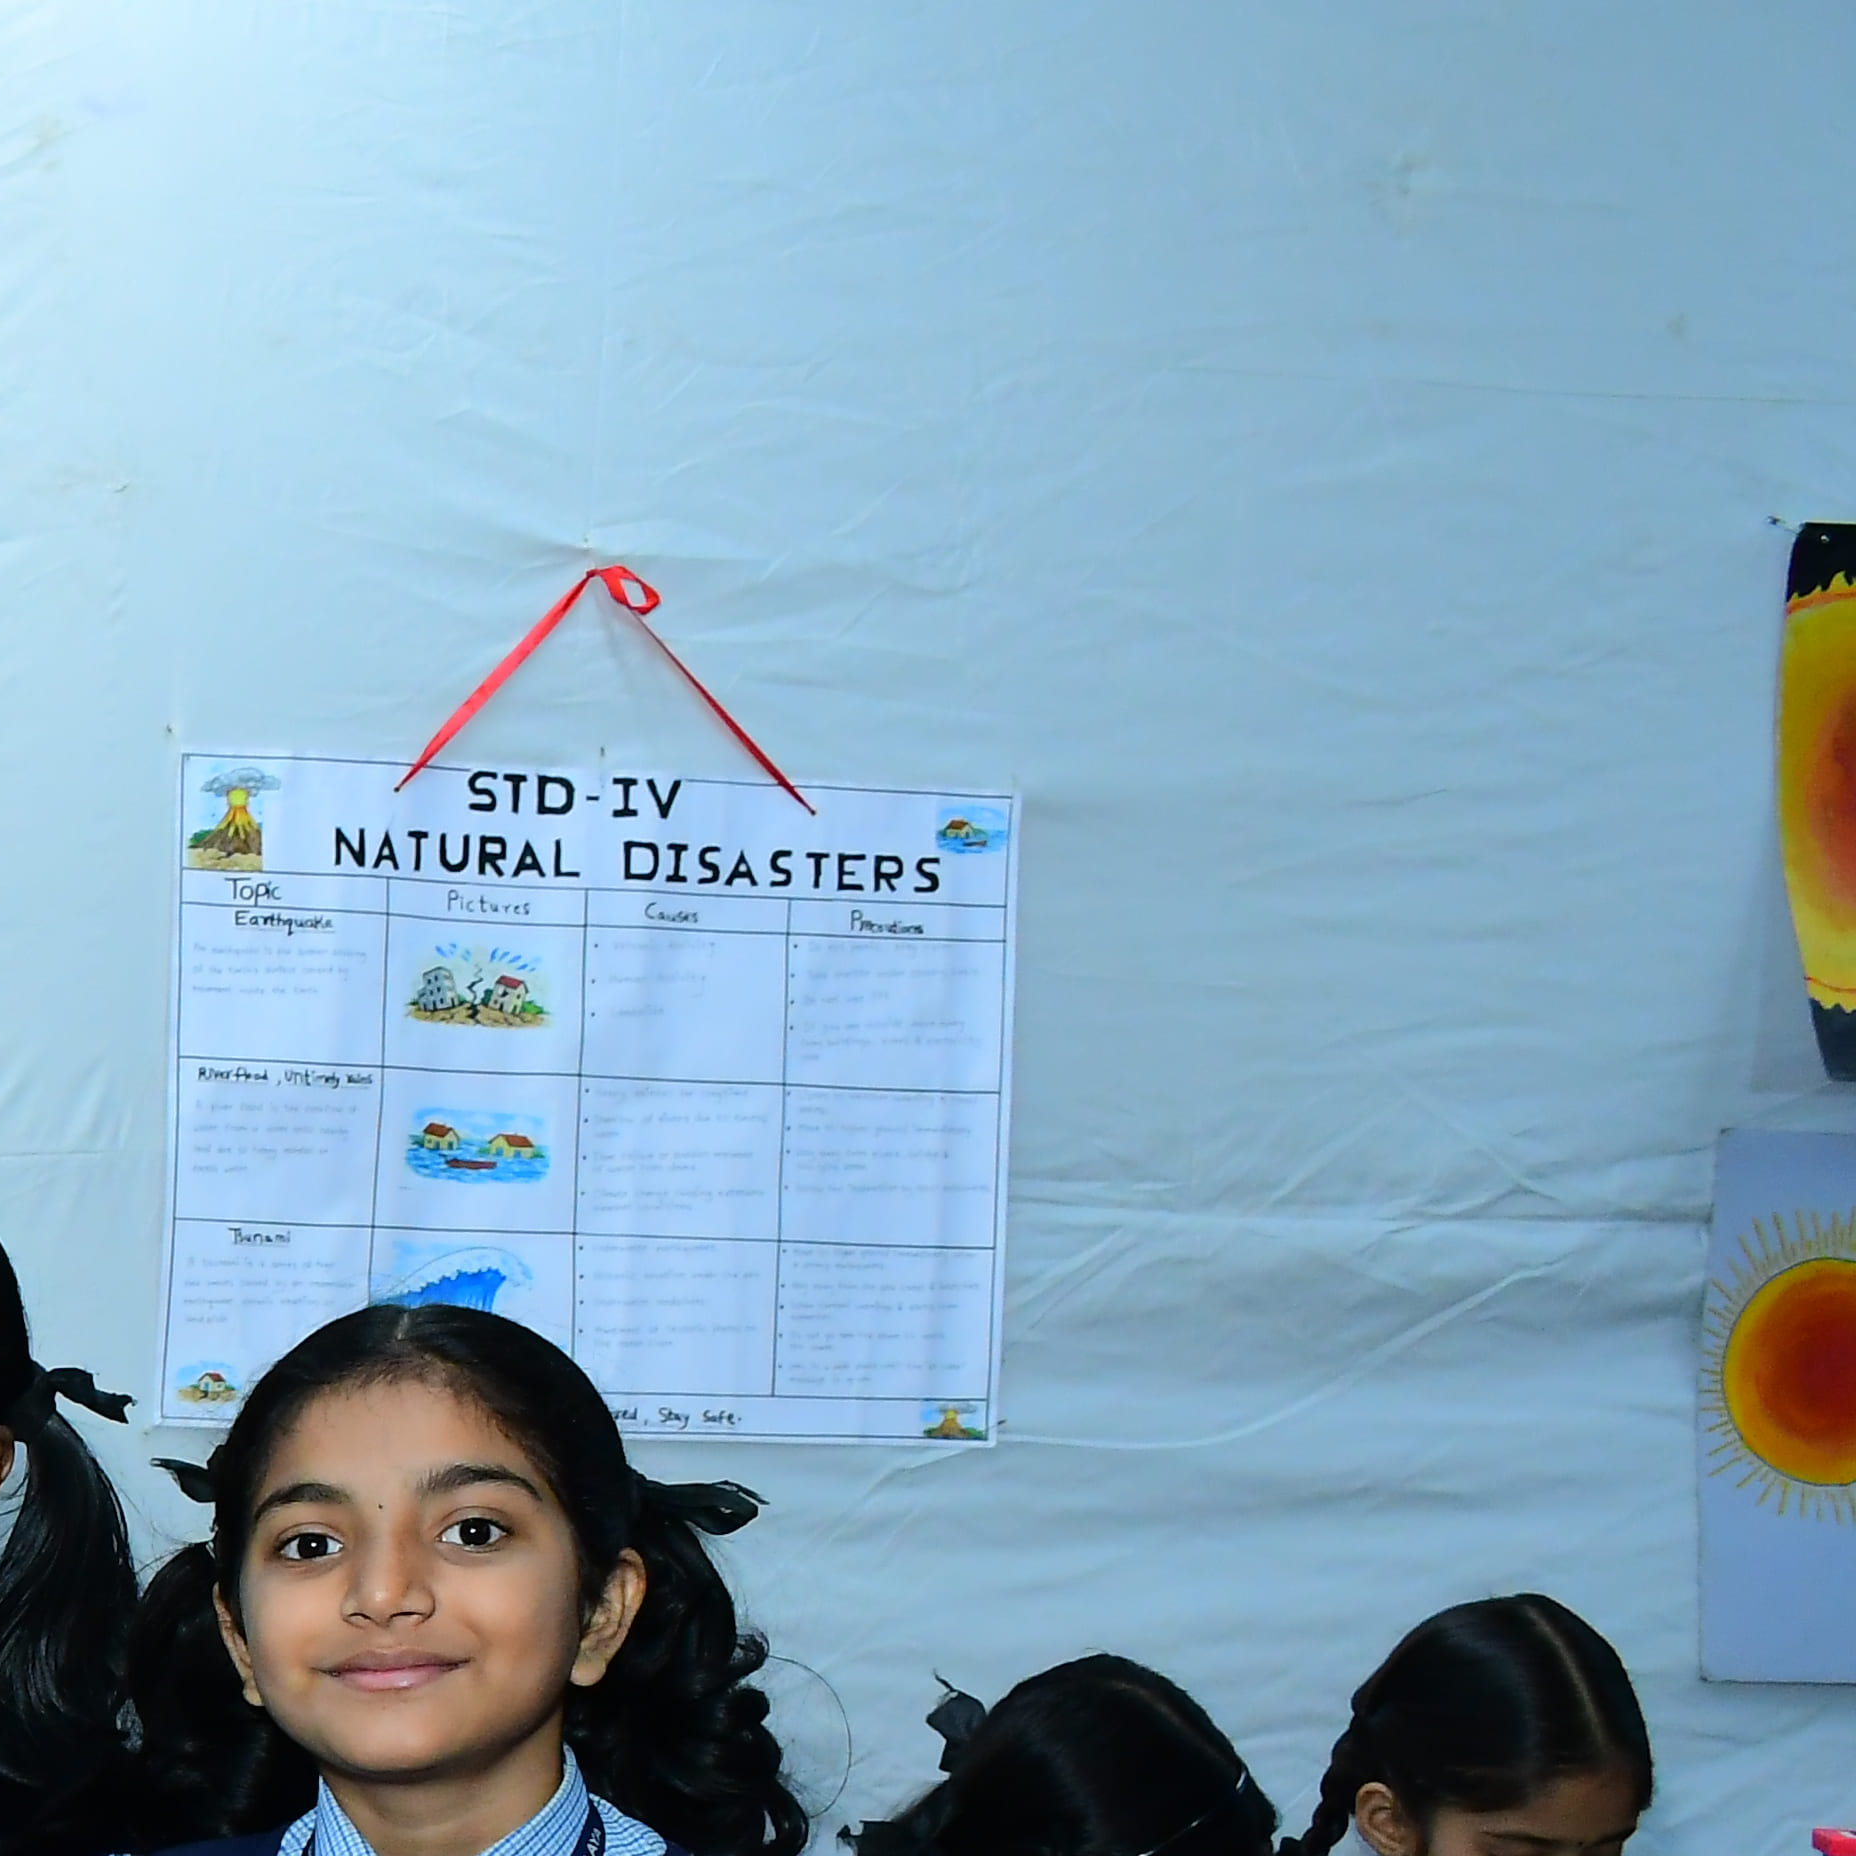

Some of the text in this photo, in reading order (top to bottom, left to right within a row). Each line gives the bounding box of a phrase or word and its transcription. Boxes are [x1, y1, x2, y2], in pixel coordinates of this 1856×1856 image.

[466, 769, 684, 820] STD-IV
[332, 825, 943, 893] NATURAL DISASTERS
[225, 878, 699, 924] Topic Pictures Causes
